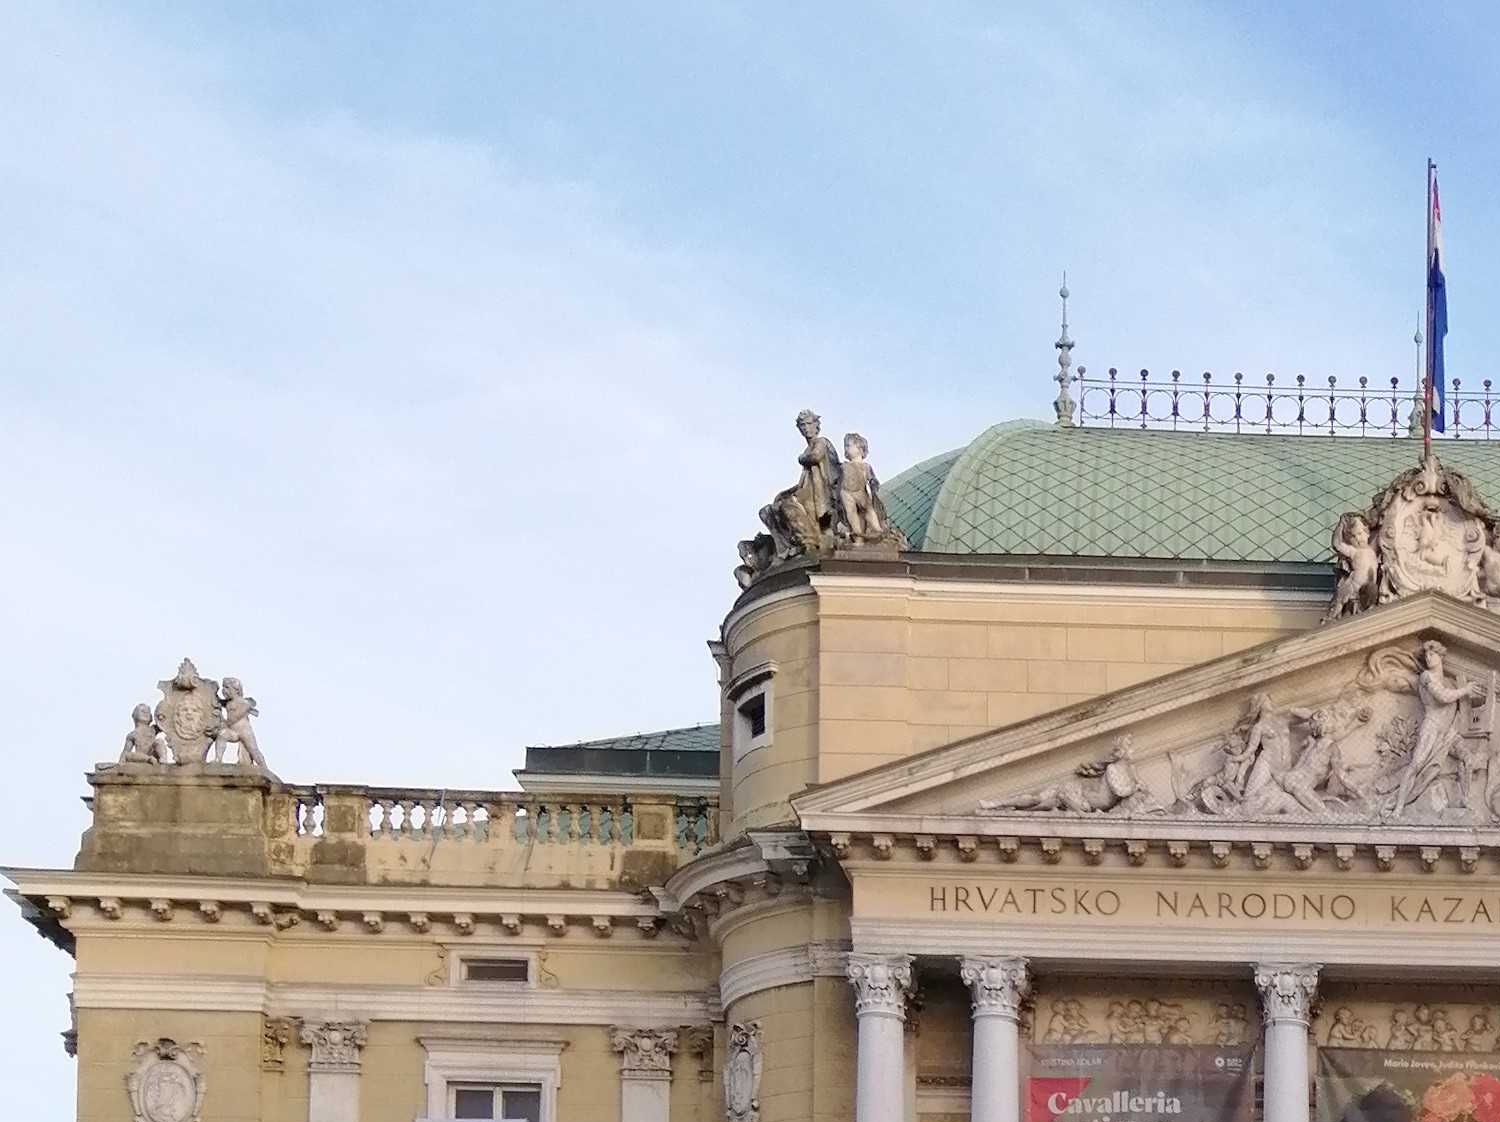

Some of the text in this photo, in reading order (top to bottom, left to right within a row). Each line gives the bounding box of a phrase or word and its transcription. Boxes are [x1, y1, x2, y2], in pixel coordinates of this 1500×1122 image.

[929, 886, 1121, 917] HRVATSKO
[1155, 890, 1357, 921] NARODNO
[1047, 1090, 1182, 1115] Cavalleria
